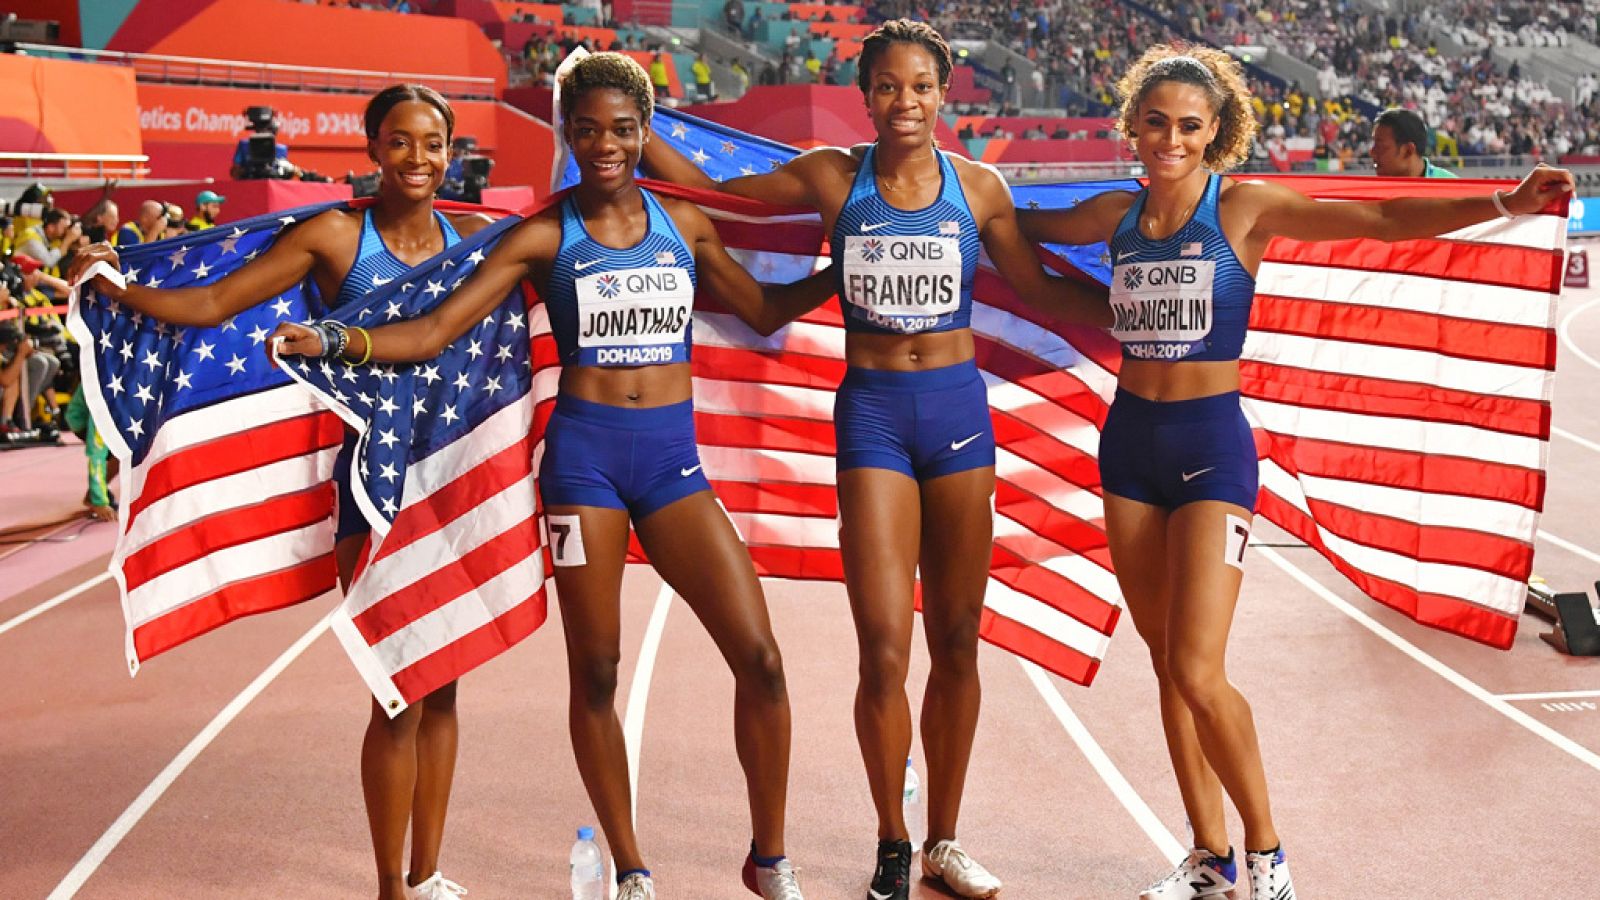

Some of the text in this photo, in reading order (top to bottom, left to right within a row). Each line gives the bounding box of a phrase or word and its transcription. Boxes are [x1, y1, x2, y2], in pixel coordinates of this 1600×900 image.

[890, 242, 944, 260] QNB
[1148, 266, 1197, 286] QNB
[1569, 256, 1585, 275] 3
[626, 273, 678, 293] QNB
[849, 274, 954, 306] FRANCIS
[583, 305, 687, 337] JONATHAS
[1113, 298, 1206, 332] McLAUGHLIN
[596, 346, 673, 364] DOHA2019
[550, 523, 571, 560] 7
[1234, 524, 1249, 563] 7
